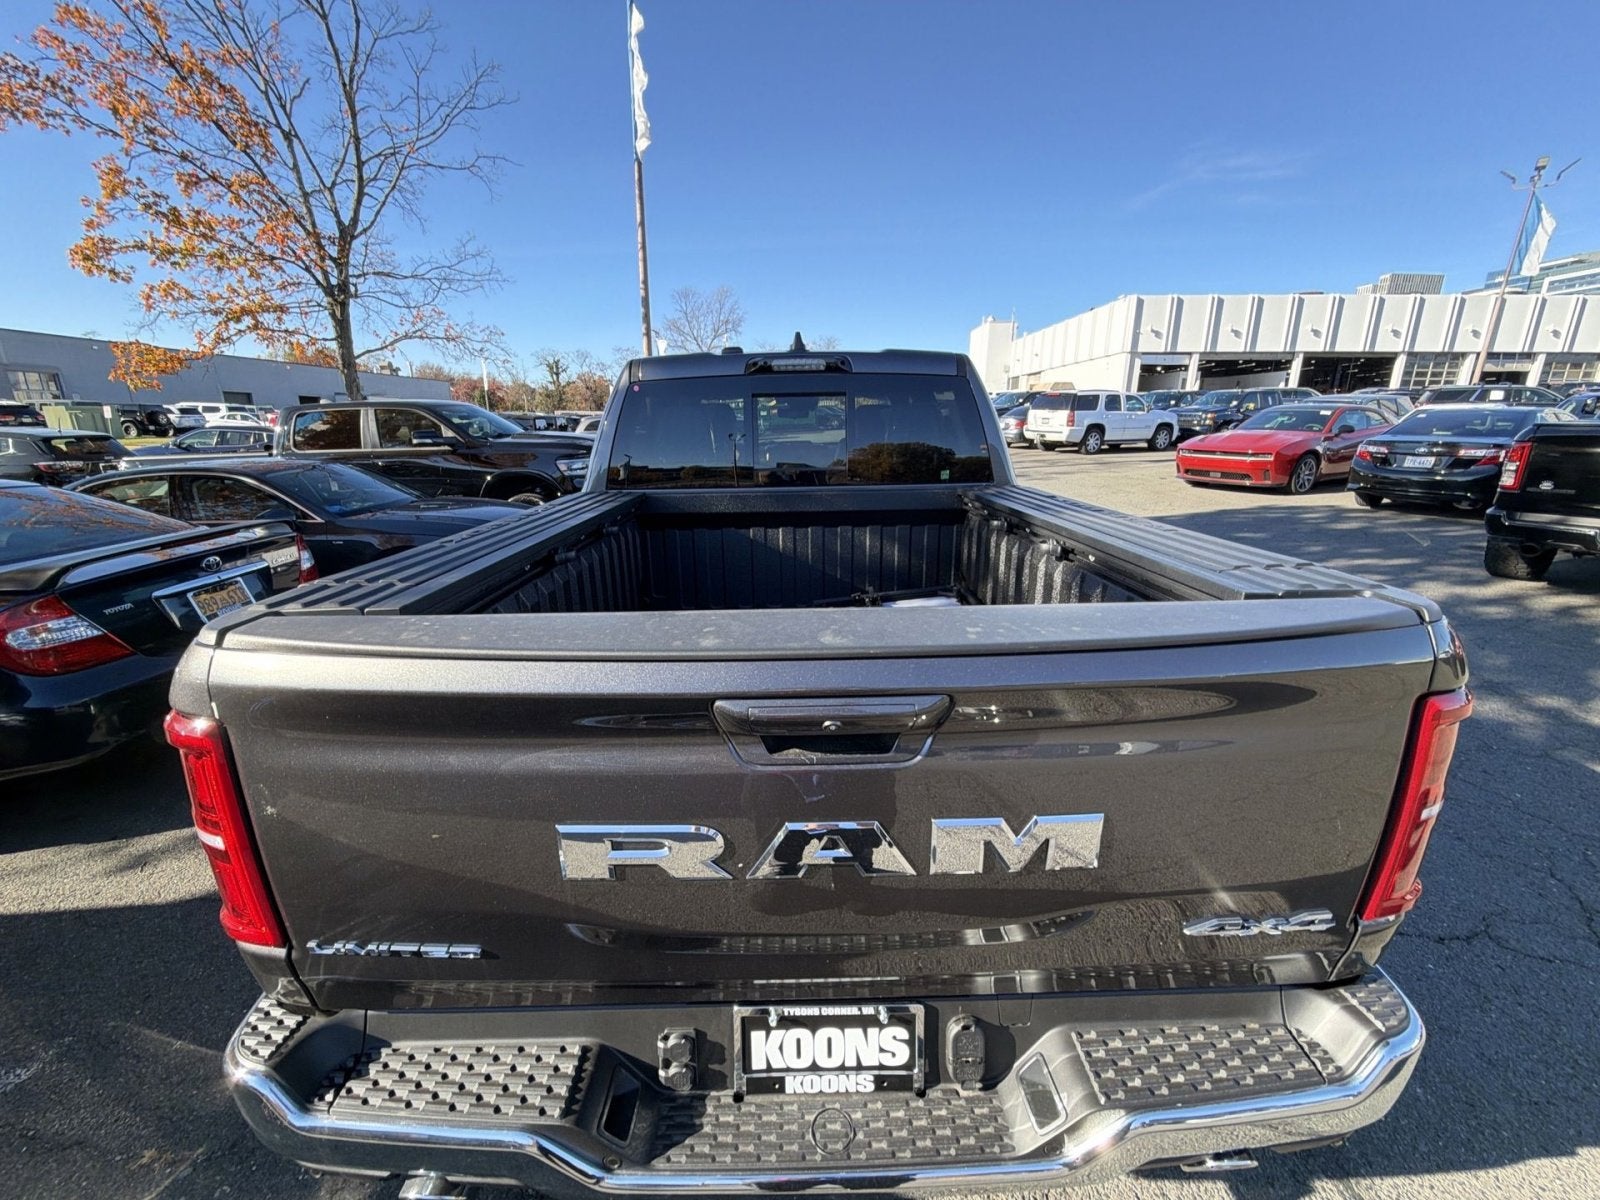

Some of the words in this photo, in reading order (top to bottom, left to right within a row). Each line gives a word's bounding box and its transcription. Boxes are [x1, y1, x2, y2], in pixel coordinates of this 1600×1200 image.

[103, 603, 134, 615] TOYOTA
[555, 813, 1105, 880] RAM
[305, 939, 482, 959] LIMITED
[783, 1007, 820, 1016] TYSONS
[862, 1005, 875, 1015] VA
[750, 1027, 911, 1071] KOONS
[785, 1074, 876, 1094] KOONS
